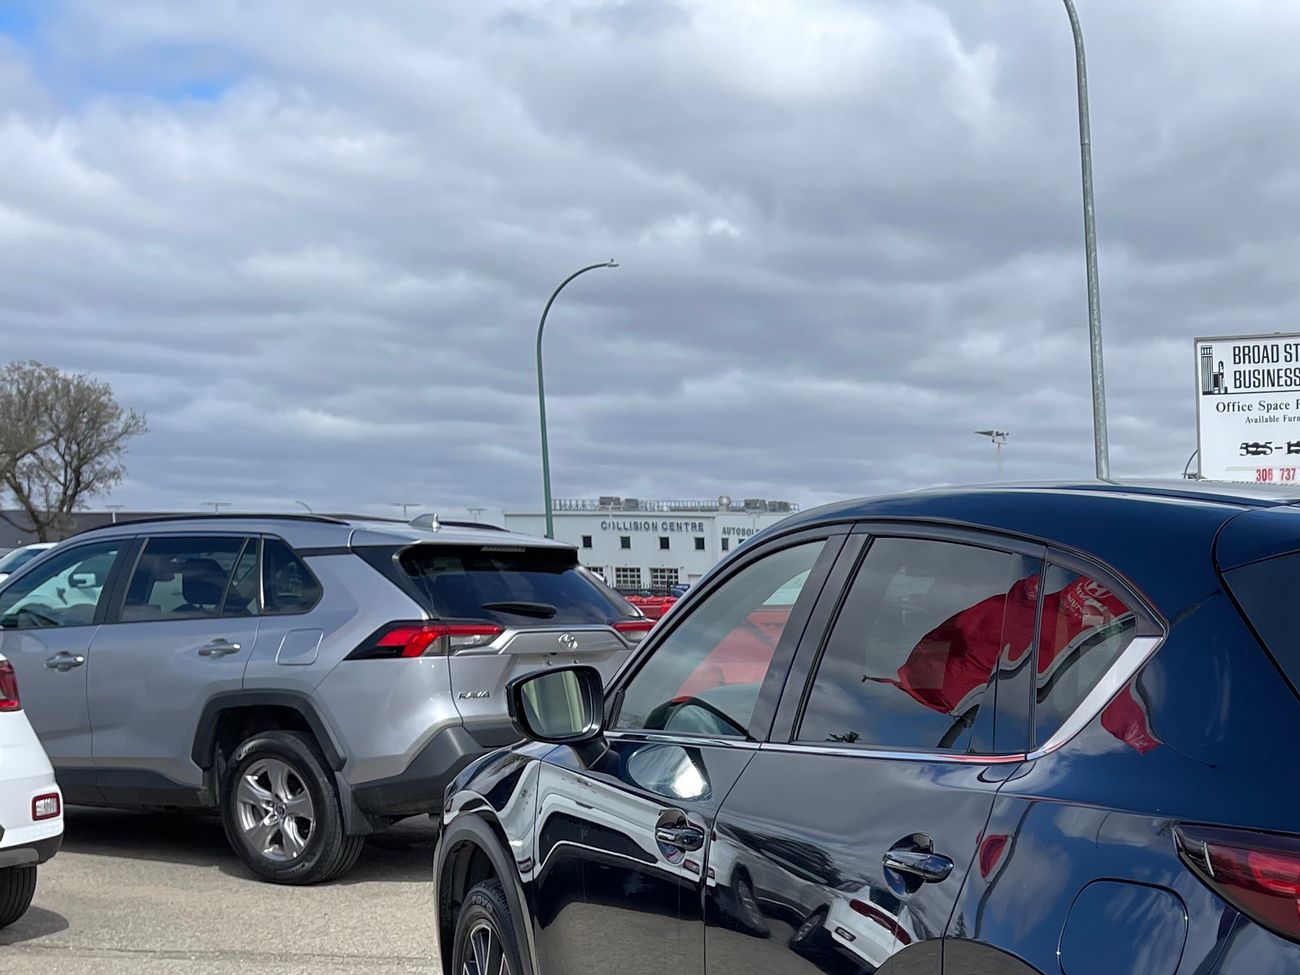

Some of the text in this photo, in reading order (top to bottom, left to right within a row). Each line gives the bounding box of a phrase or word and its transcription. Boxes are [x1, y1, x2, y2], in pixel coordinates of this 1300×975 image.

[1233, 344, 1280, 365] BROAD
[1215, 401, 1253, 413] Office
[1258, 400, 1290, 416] Space
[1244, 415, 1280, 424] Available
[1255, 468, 1273, 482] 306
[1279, 467, 1296, 481] 737
[600, 520, 705, 533] COLLISION CENTRE
